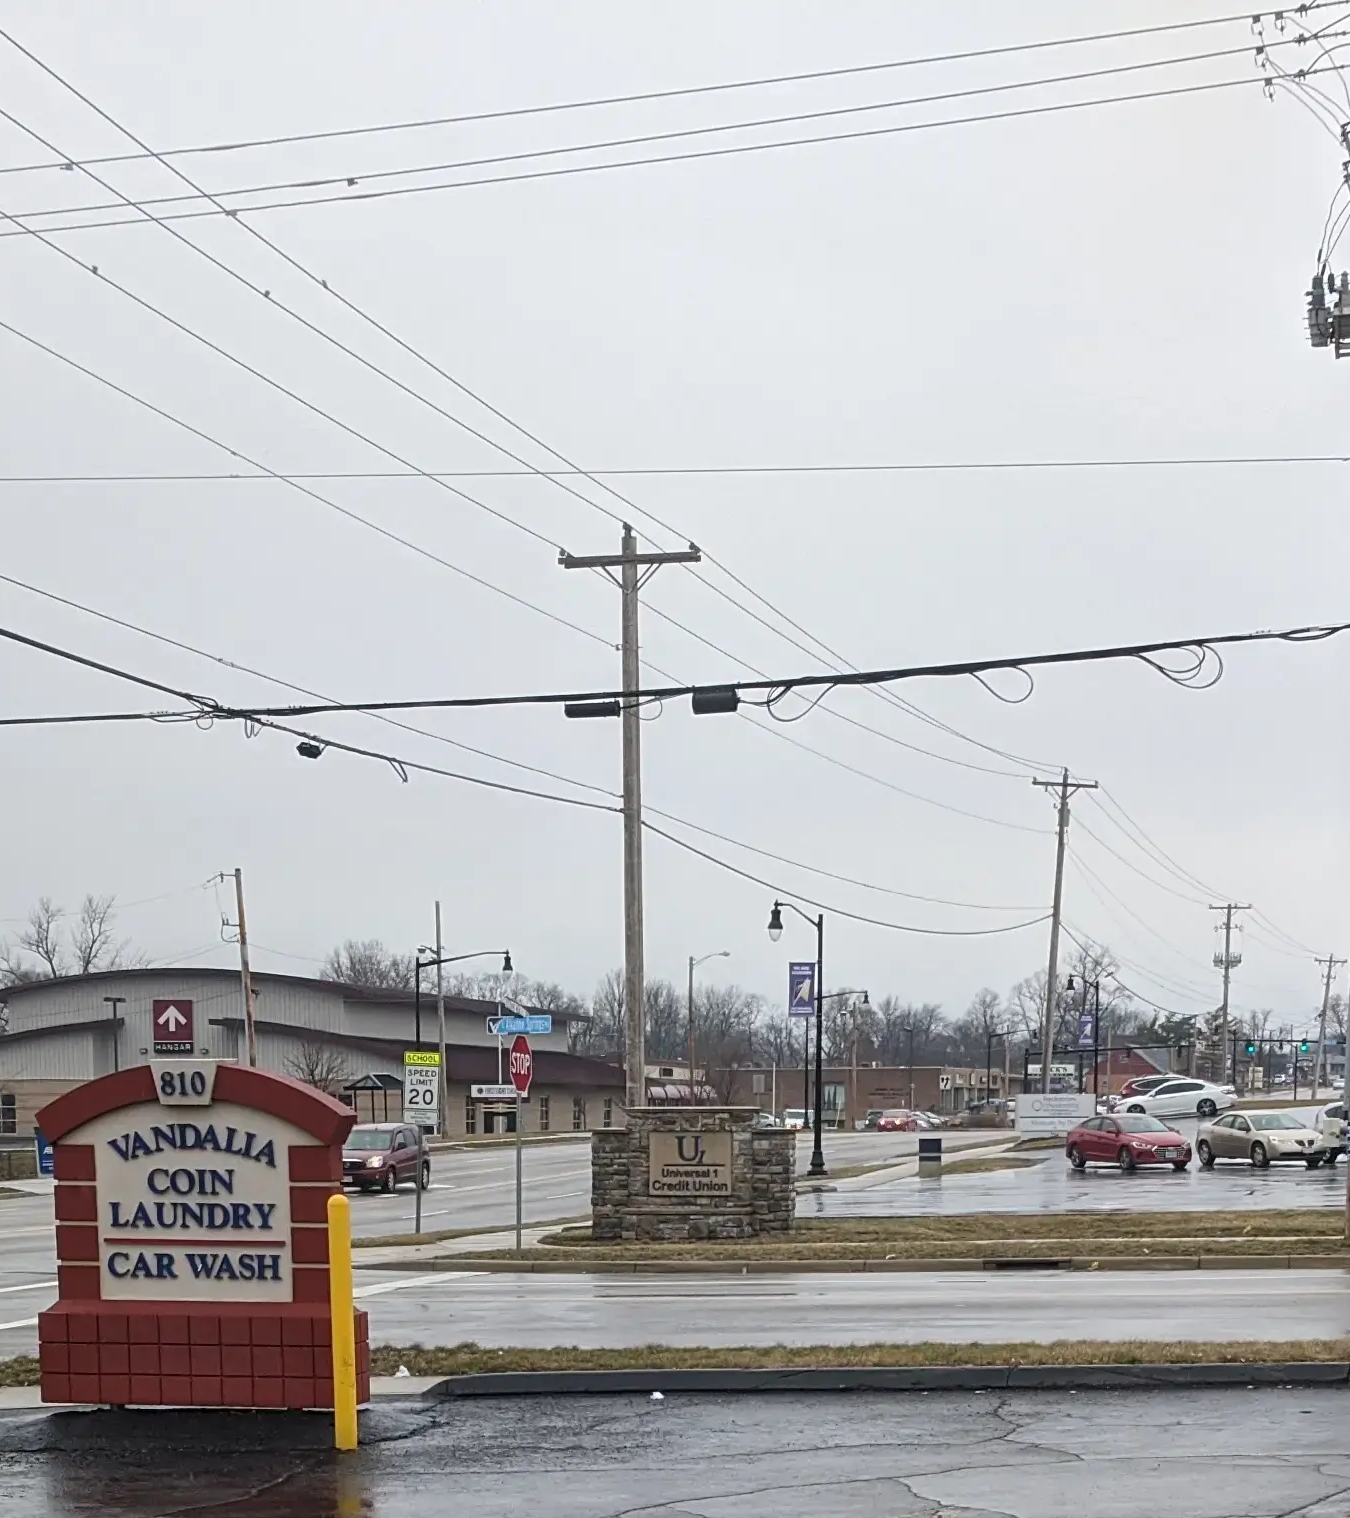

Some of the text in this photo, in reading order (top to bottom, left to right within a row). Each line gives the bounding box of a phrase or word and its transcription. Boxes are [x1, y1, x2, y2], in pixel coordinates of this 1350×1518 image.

[407, 1054, 437, 1063] SCHOOL
[511, 1052, 531, 1075] STOP
[160, 1071, 206, 1096] 810
[408, 1069, 437, 1078] SPEED
[408, 1088, 434, 1106] 20
[107, 1123, 277, 1168] VANDALIA
[147, 1168, 235, 1196] COIN
[661, 1168, 718, 1178] Universal 1
[652, 1180, 728, 1191] Credit Union
[109, 1201, 276, 1229] LAUNDRY
[107, 1252, 283, 1281] CAR WASH
